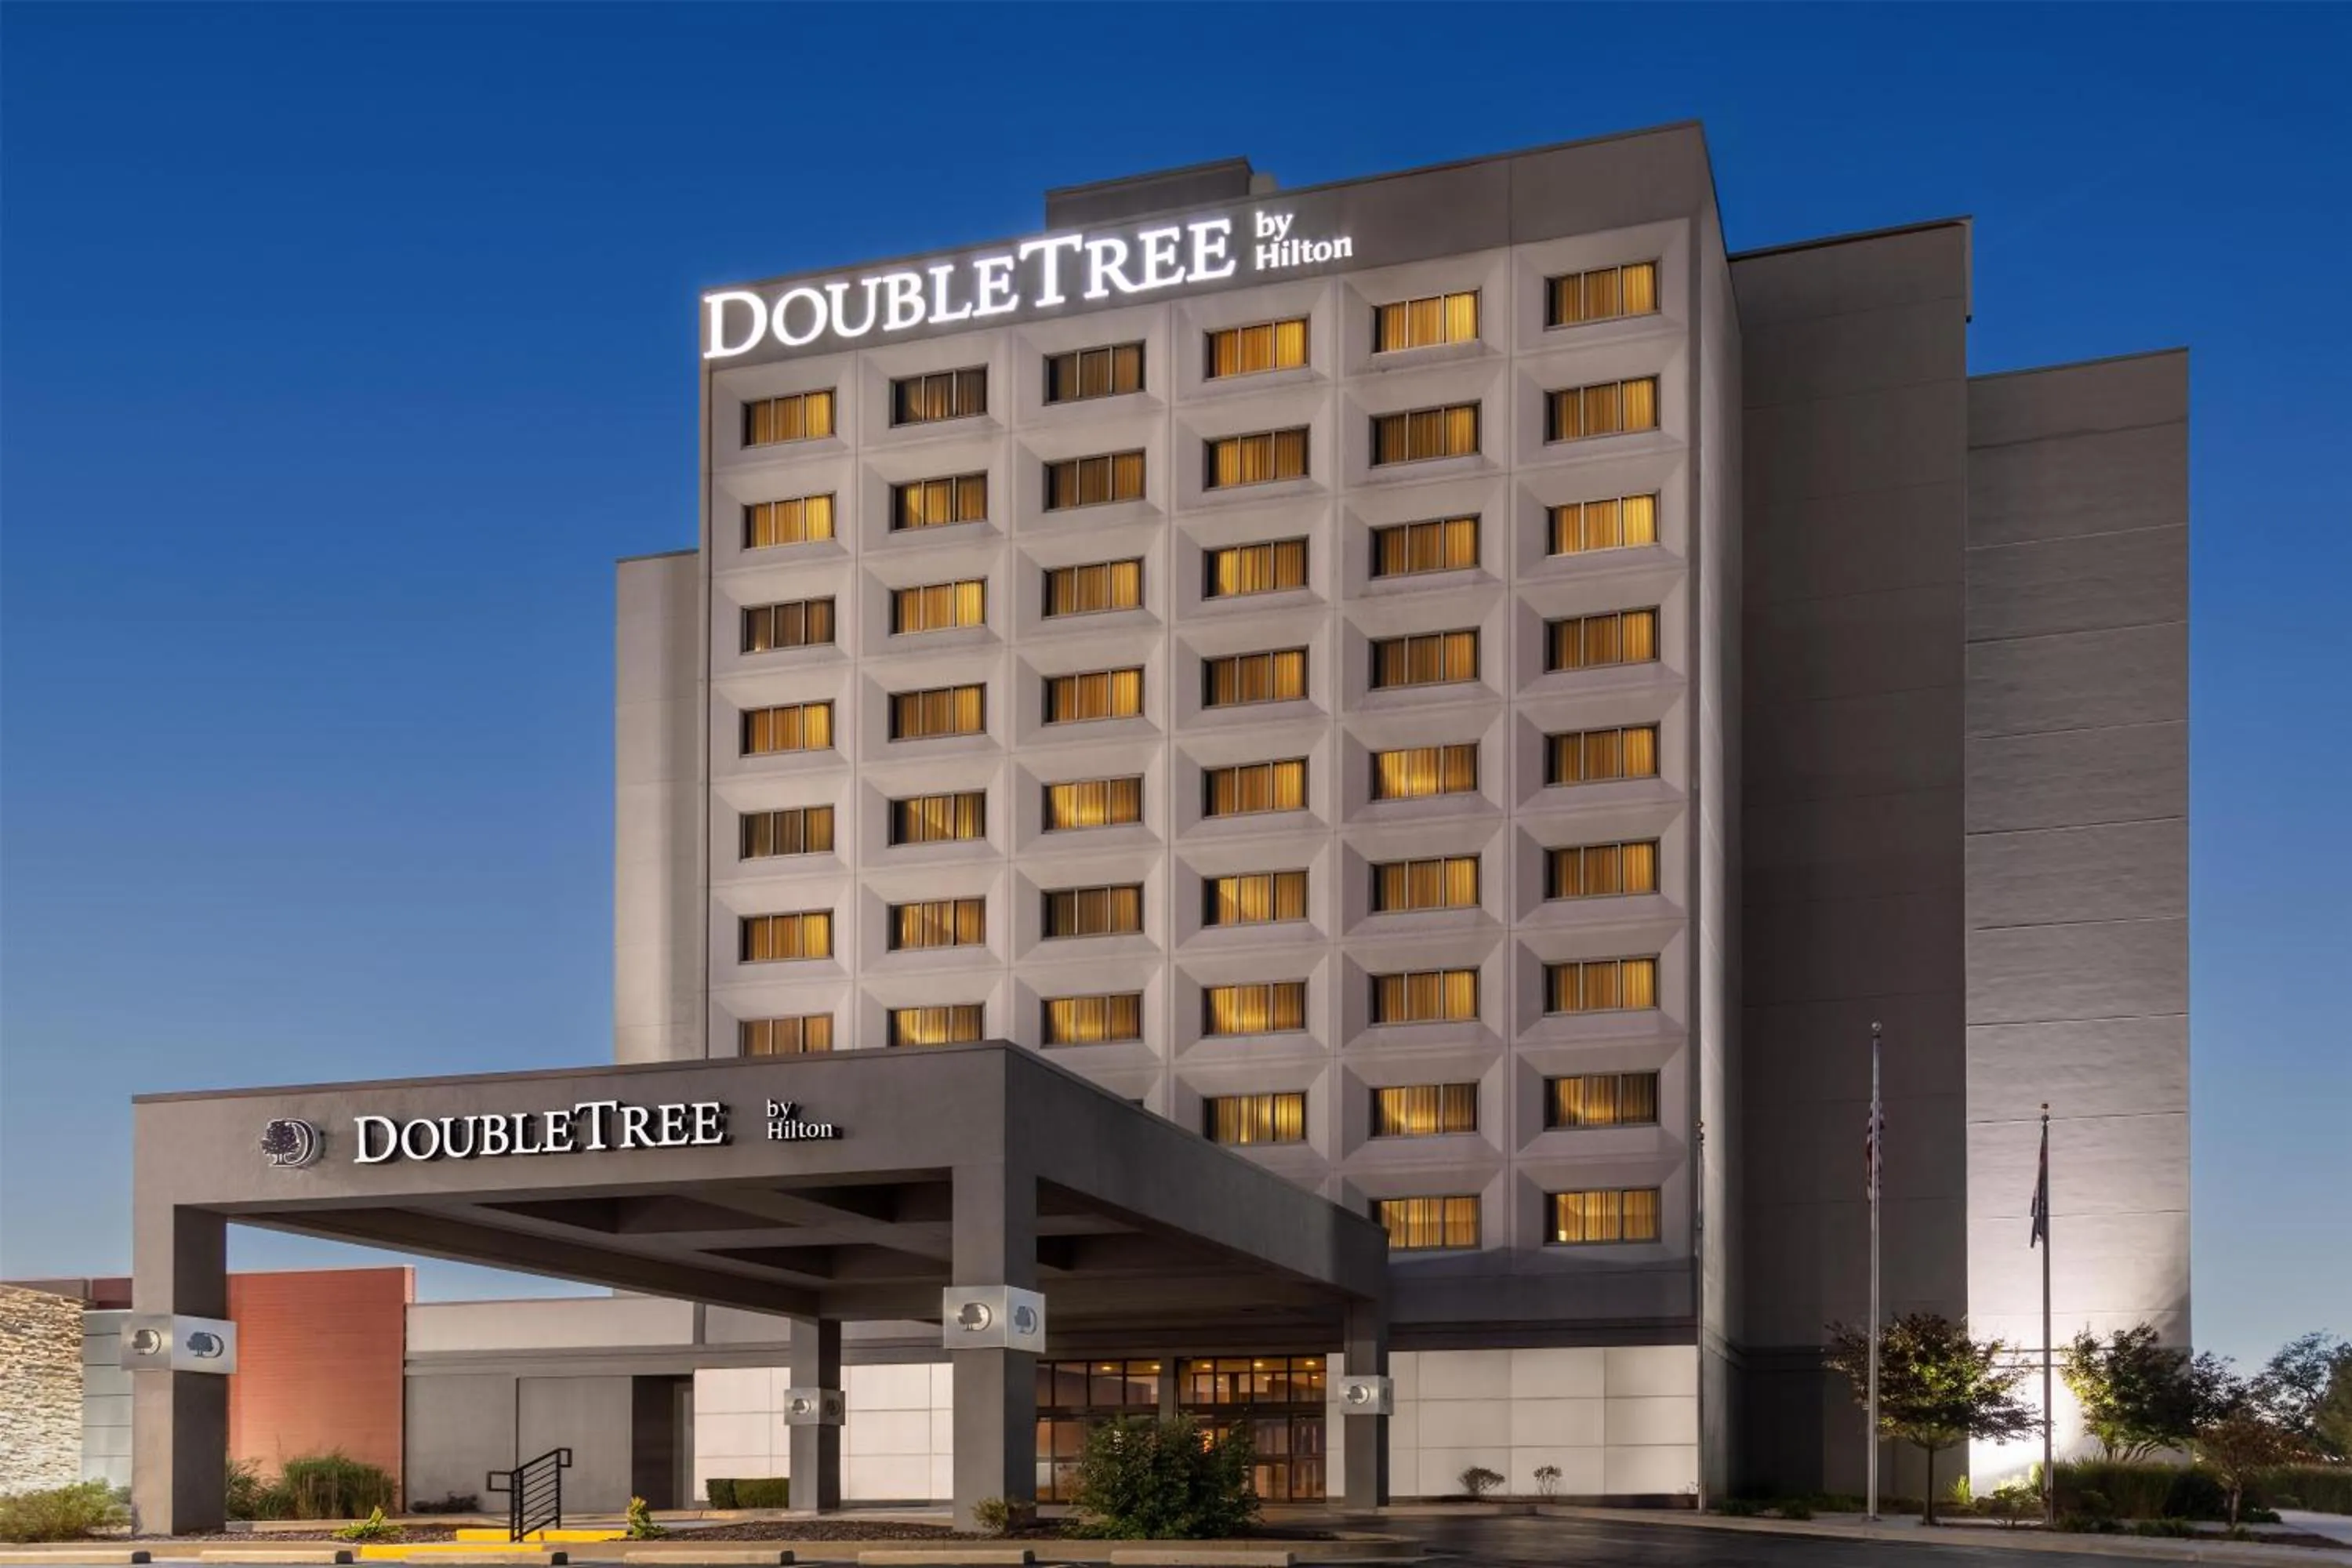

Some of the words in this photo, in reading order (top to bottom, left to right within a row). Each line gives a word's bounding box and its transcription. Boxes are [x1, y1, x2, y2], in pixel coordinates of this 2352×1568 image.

[1256, 211, 1294, 242] by
[1256, 235, 1353, 270] Hilton
[766, 1098, 792, 1120] by
[767, 1120, 833, 1139] Hilton
